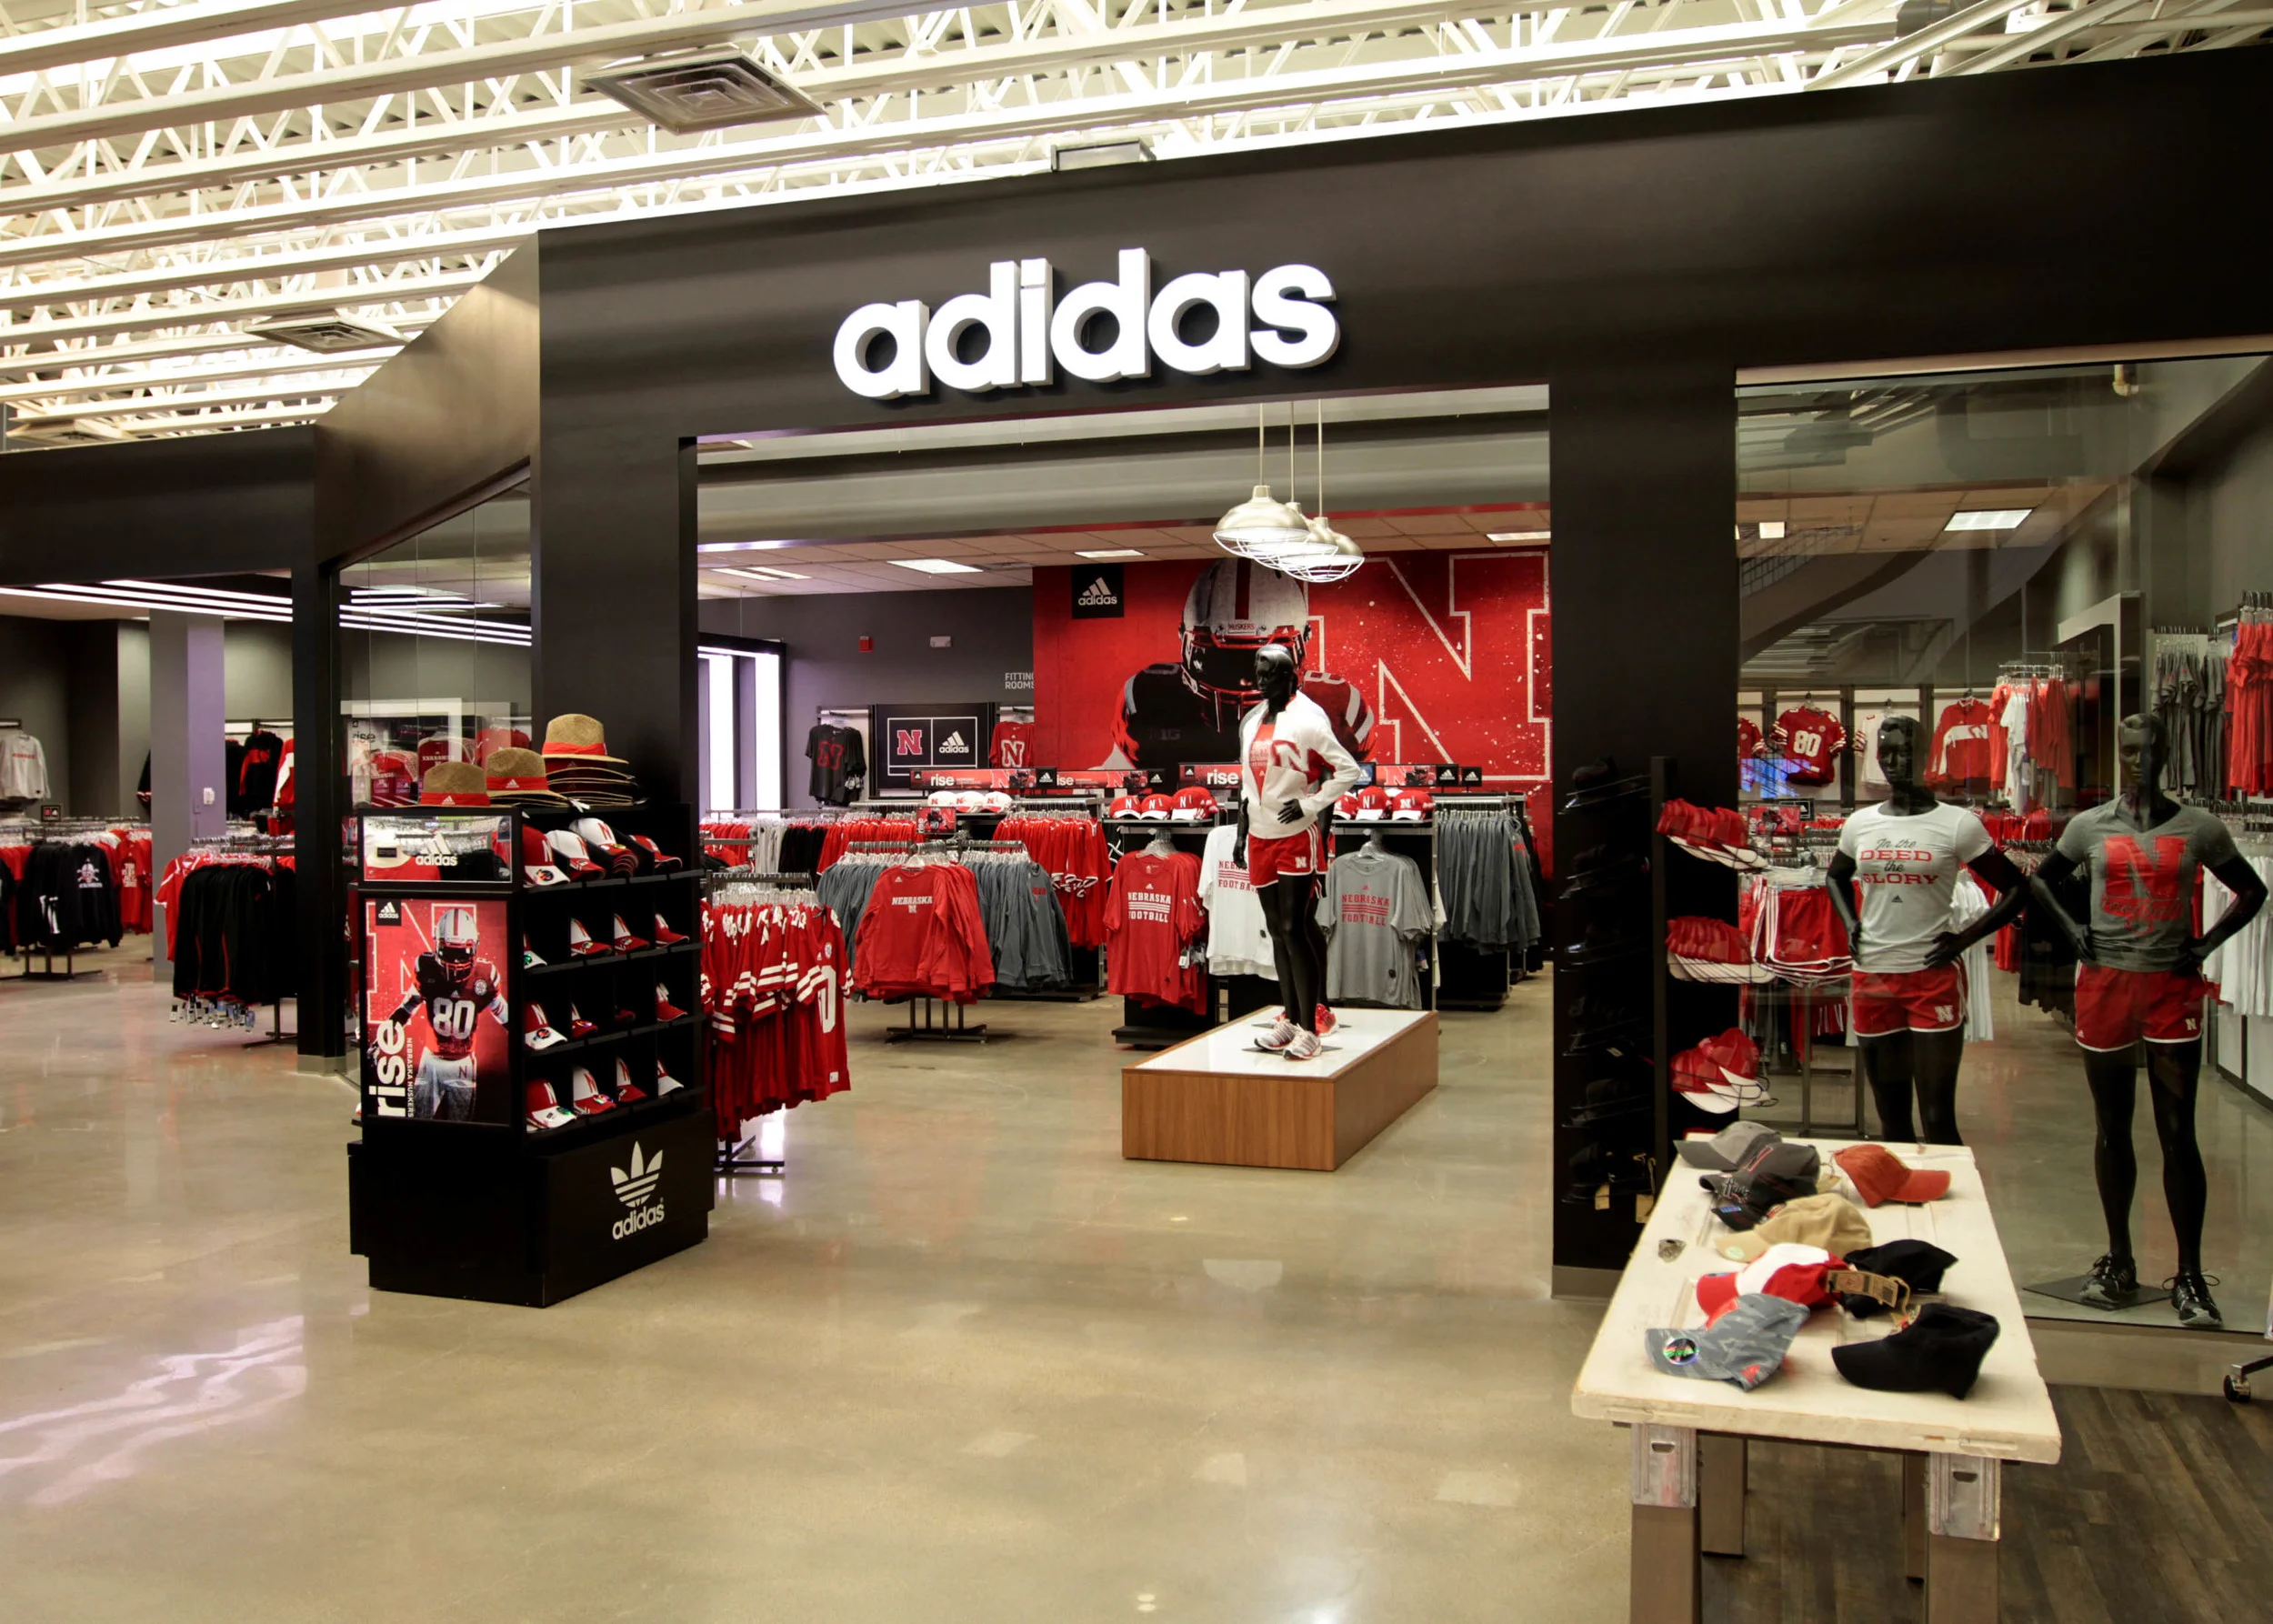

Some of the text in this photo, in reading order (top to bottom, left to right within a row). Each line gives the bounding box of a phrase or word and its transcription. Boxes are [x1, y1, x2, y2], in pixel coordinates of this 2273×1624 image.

[834, 247, 1341, 401] adidas
[1077, 594, 1118, 606] adidas
[896, 729, 923, 757] N
[938, 745, 969, 754] adidas
[1793, 730, 1822, 757] 80
[1002, 739, 1025, 768] N
[930, 773, 955, 787] rise
[1056, 774, 1075, 787] ise
[1207, 768, 1239, 786] rise
[415, 852, 457, 867] adidas
[1859, 849, 1933, 862] DEED
[1884, 860, 1905, 872] the
[891, 895, 933, 906] NEBRASKA
[1127, 891, 1172, 905] NEBRASKA
[1341, 914, 1387, 927] FOOTALL
[433, 997, 472, 1039] 80
[368, 1019, 406, 1118] rise
[612, 1205, 665, 1240] adidas
